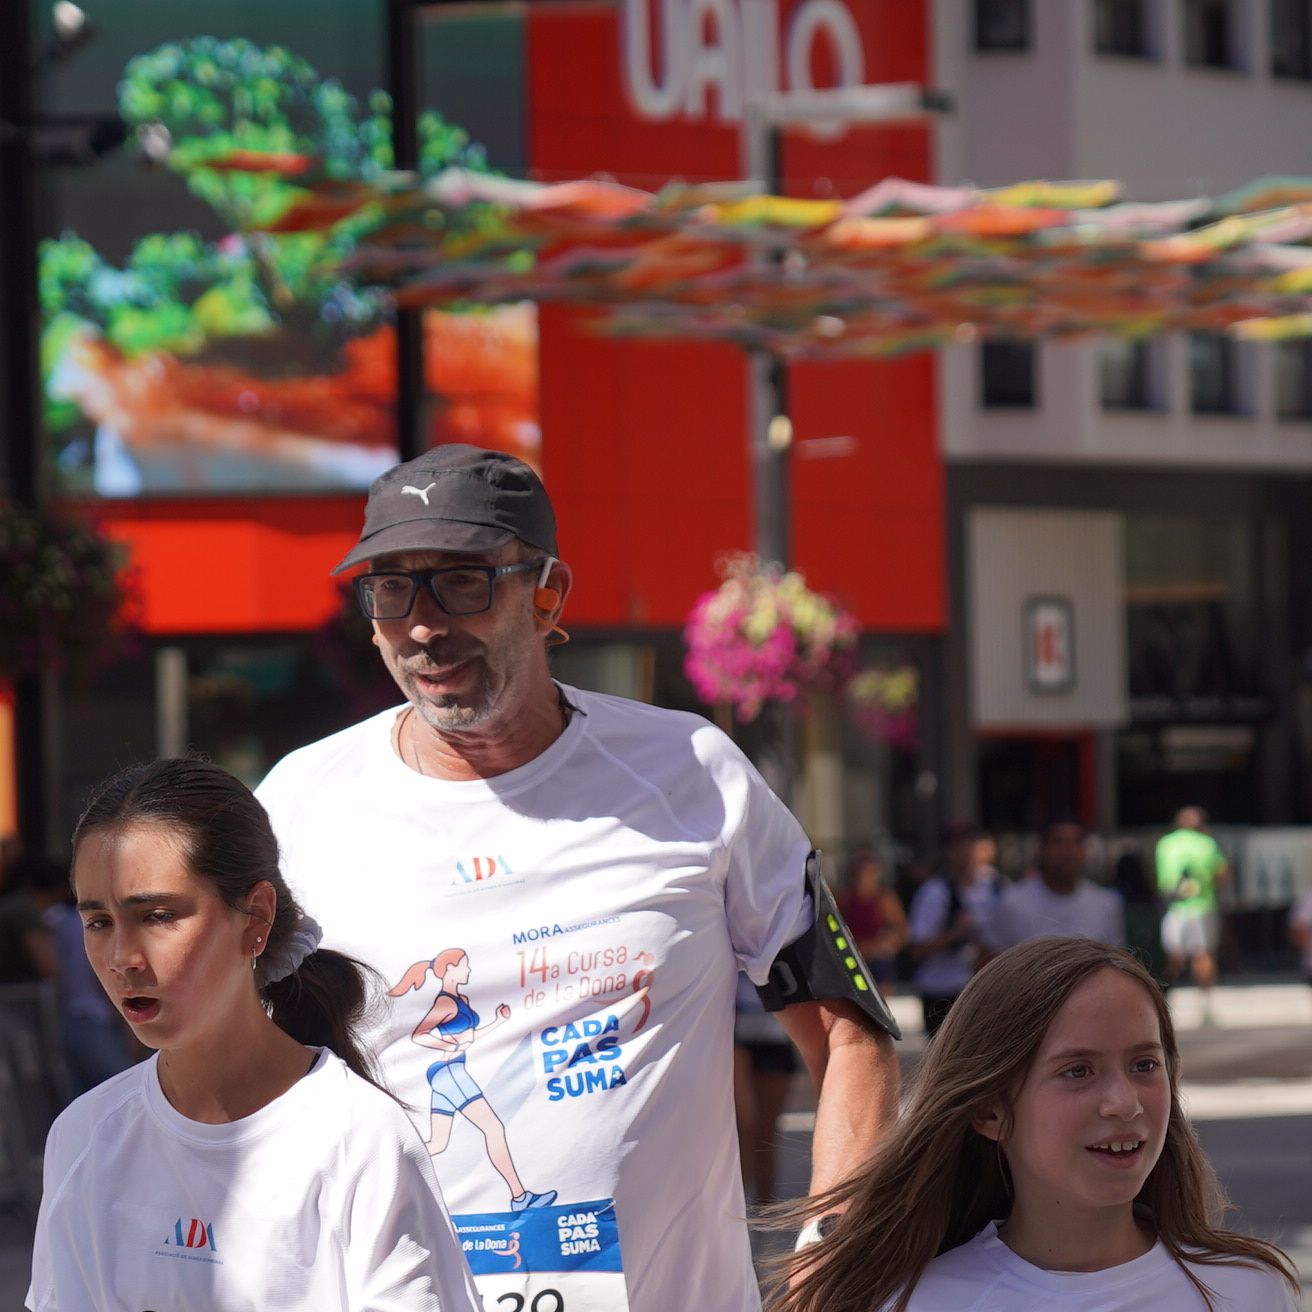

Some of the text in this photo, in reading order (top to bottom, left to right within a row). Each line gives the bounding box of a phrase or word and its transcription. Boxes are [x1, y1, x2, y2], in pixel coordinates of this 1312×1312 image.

[450, 854, 514, 886] ADA
[512, 915, 622, 945] MORA ASSEGURANCES
[568, 945, 628, 975] Cursa
[524, 973, 627, 1010] de la Dona
[540, 1014, 620, 1047] CADA
[542, 1036, 623, 1074] PAS
[546, 1064, 628, 1102] SUMA
[163, 1216, 217, 1252] ADA
[557, 1213, 598, 1228] CADA
[557, 1223, 600, 1242] PAS
[462, 1238, 507, 1251] de la Dona
[560, 1239, 601, 1256] SUMA
